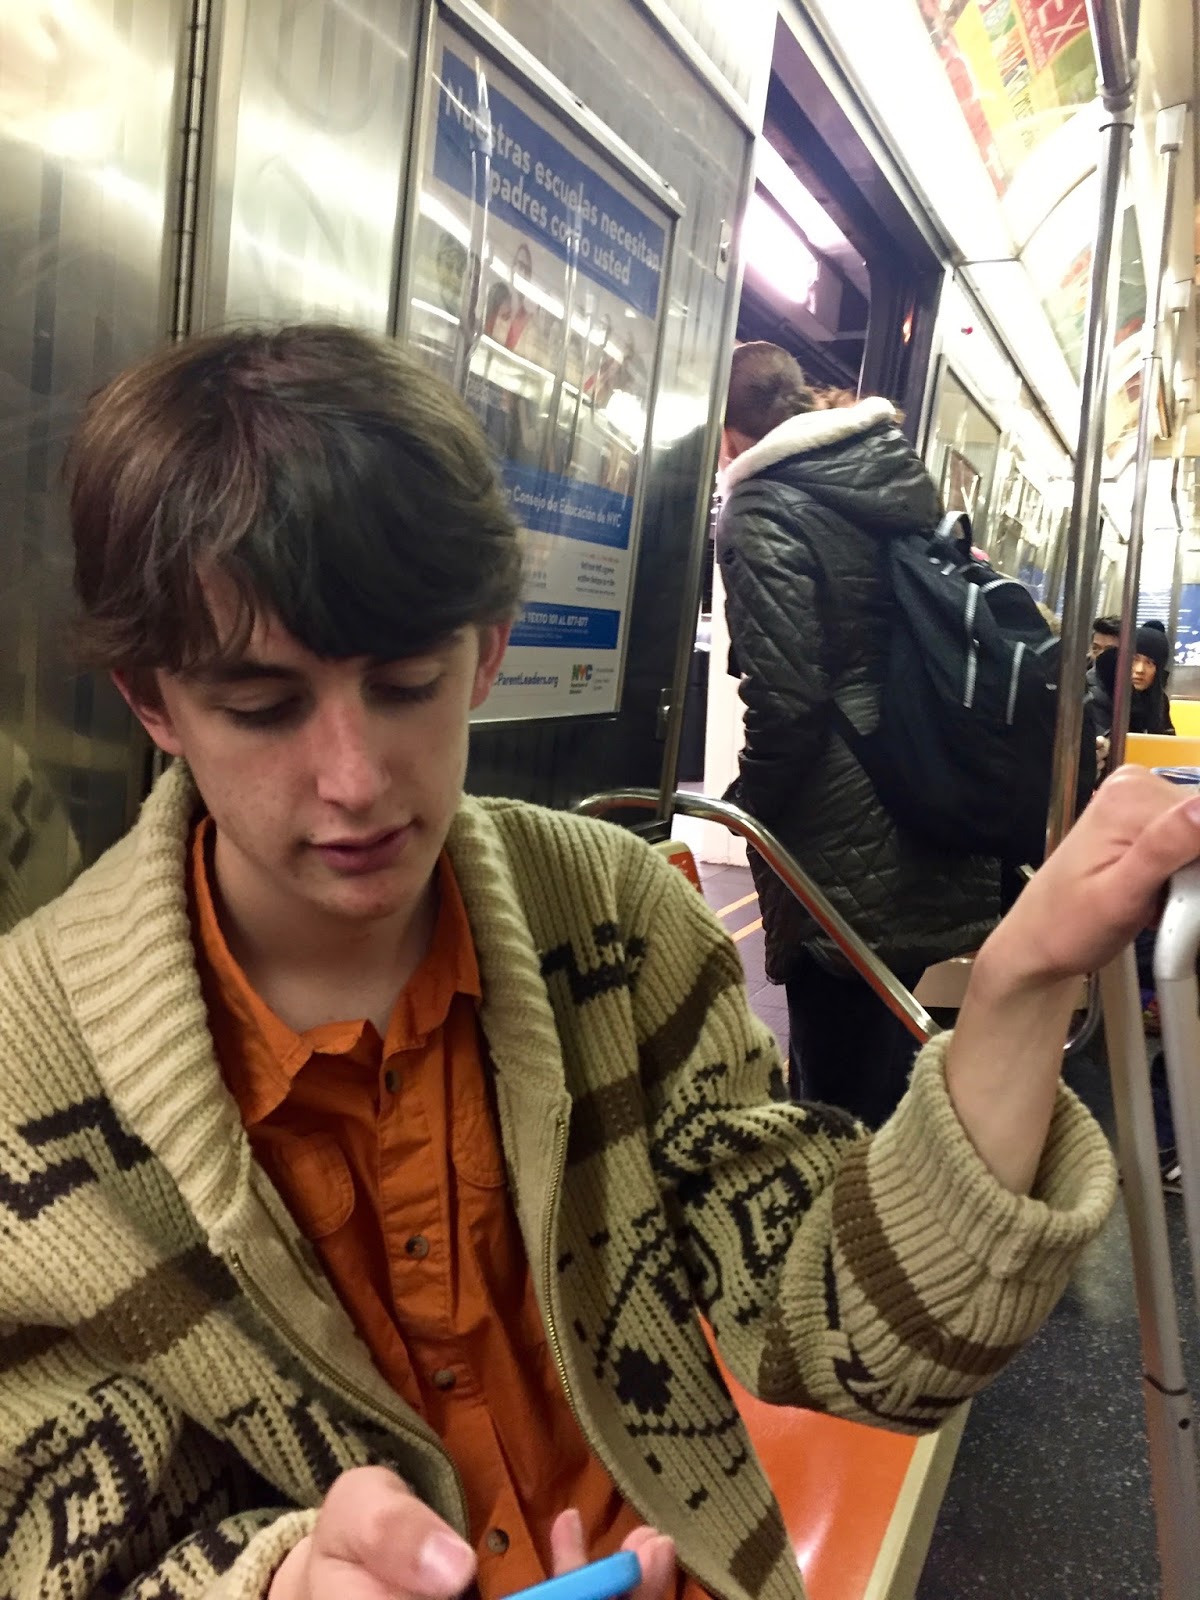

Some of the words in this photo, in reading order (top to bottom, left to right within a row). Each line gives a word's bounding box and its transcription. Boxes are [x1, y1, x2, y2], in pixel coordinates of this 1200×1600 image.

[445, 78, 531, 175] Nuestras
[535, 161, 599, 226] escuelas
[601, 212, 661, 272] necesitan
[488, 168, 548, 229] padres
[593, 245, 632, 286] usted
[513, 485, 546, 512] Consejo
[547, 495, 558, 512] de
[606, 511, 622, 528] NYC
[496, 672, 559, 688] ParentLeaders.org
[571, 663, 593, 681] NYC
